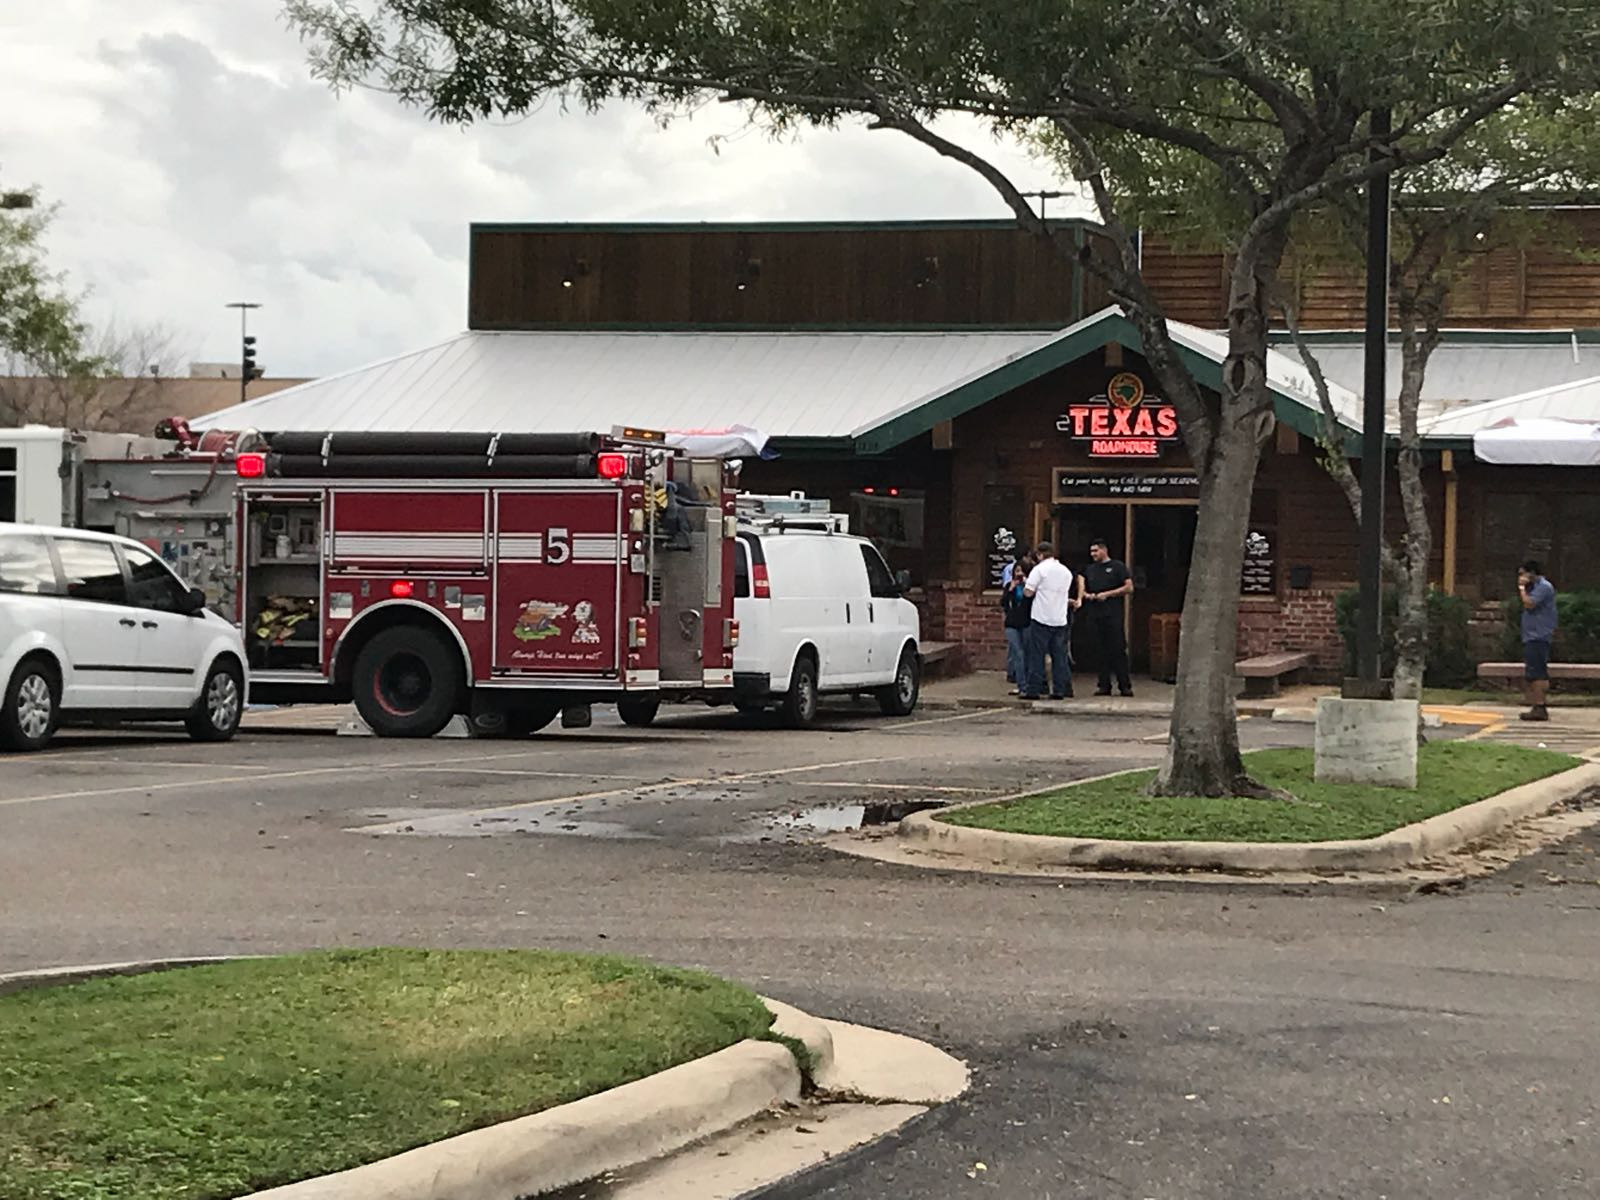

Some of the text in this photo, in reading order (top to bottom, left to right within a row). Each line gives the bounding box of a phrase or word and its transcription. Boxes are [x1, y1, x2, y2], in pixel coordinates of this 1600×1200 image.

[1069, 407, 1177, 437] TEXAS
[1092, 440, 1157, 454] ROADHOUSE
[547, 528, 570, 564] 5
